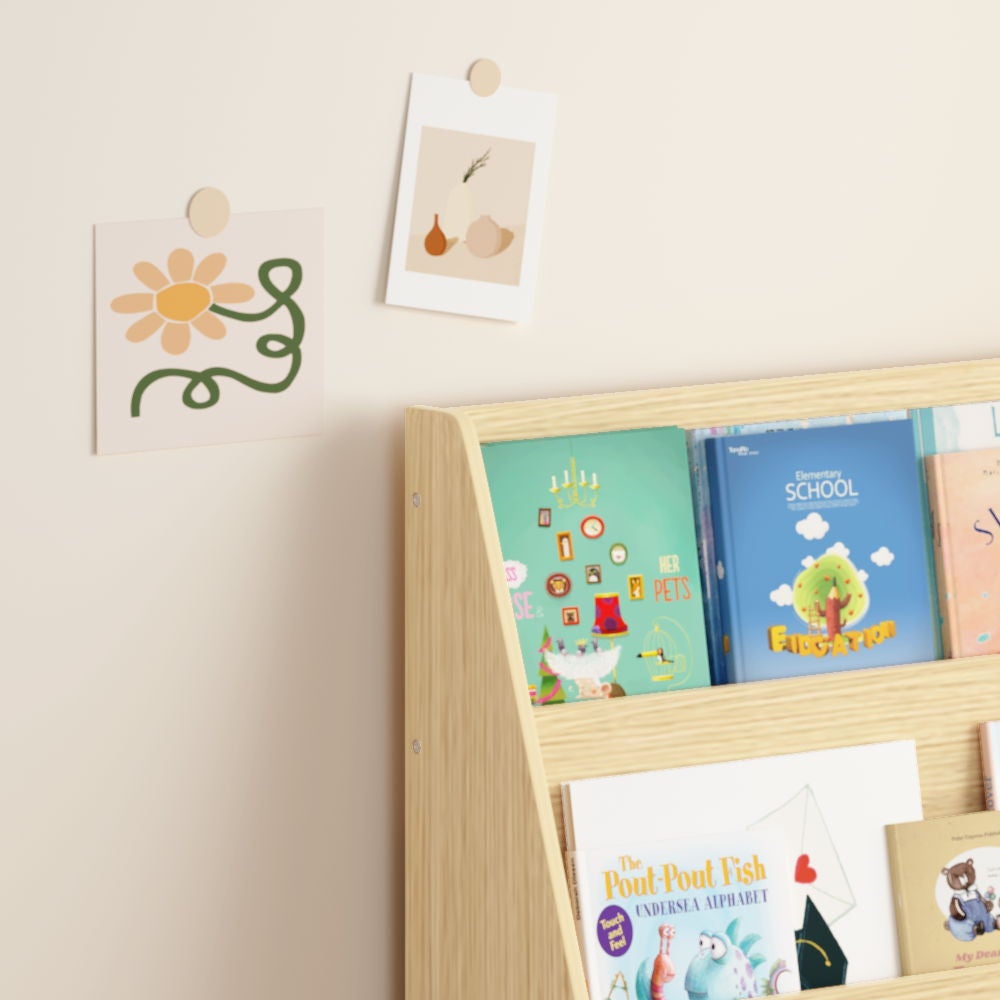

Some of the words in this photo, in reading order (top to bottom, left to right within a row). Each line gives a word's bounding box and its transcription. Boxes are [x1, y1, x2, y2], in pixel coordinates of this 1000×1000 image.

[795, 470, 842, 481] Elementary
[785, 479, 859, 502] SCHOOL
[658, 554, 680, 574] HER
[653, 576, 691, 602] PETS
[619, 855, 642, 872] The
[602, 859, 717, 900] Pout-Pout
[719, 854, 767, 887] Fish
[635, 898, 701, 918] UNDERSEA
[704, 888, 768, 911] ALPHABET
[600, 912, 626, 931] Touch
[608, 924, 624, 940] and
[609, 936, 627, 952] Feel
[955, 952, 975, 963] My
